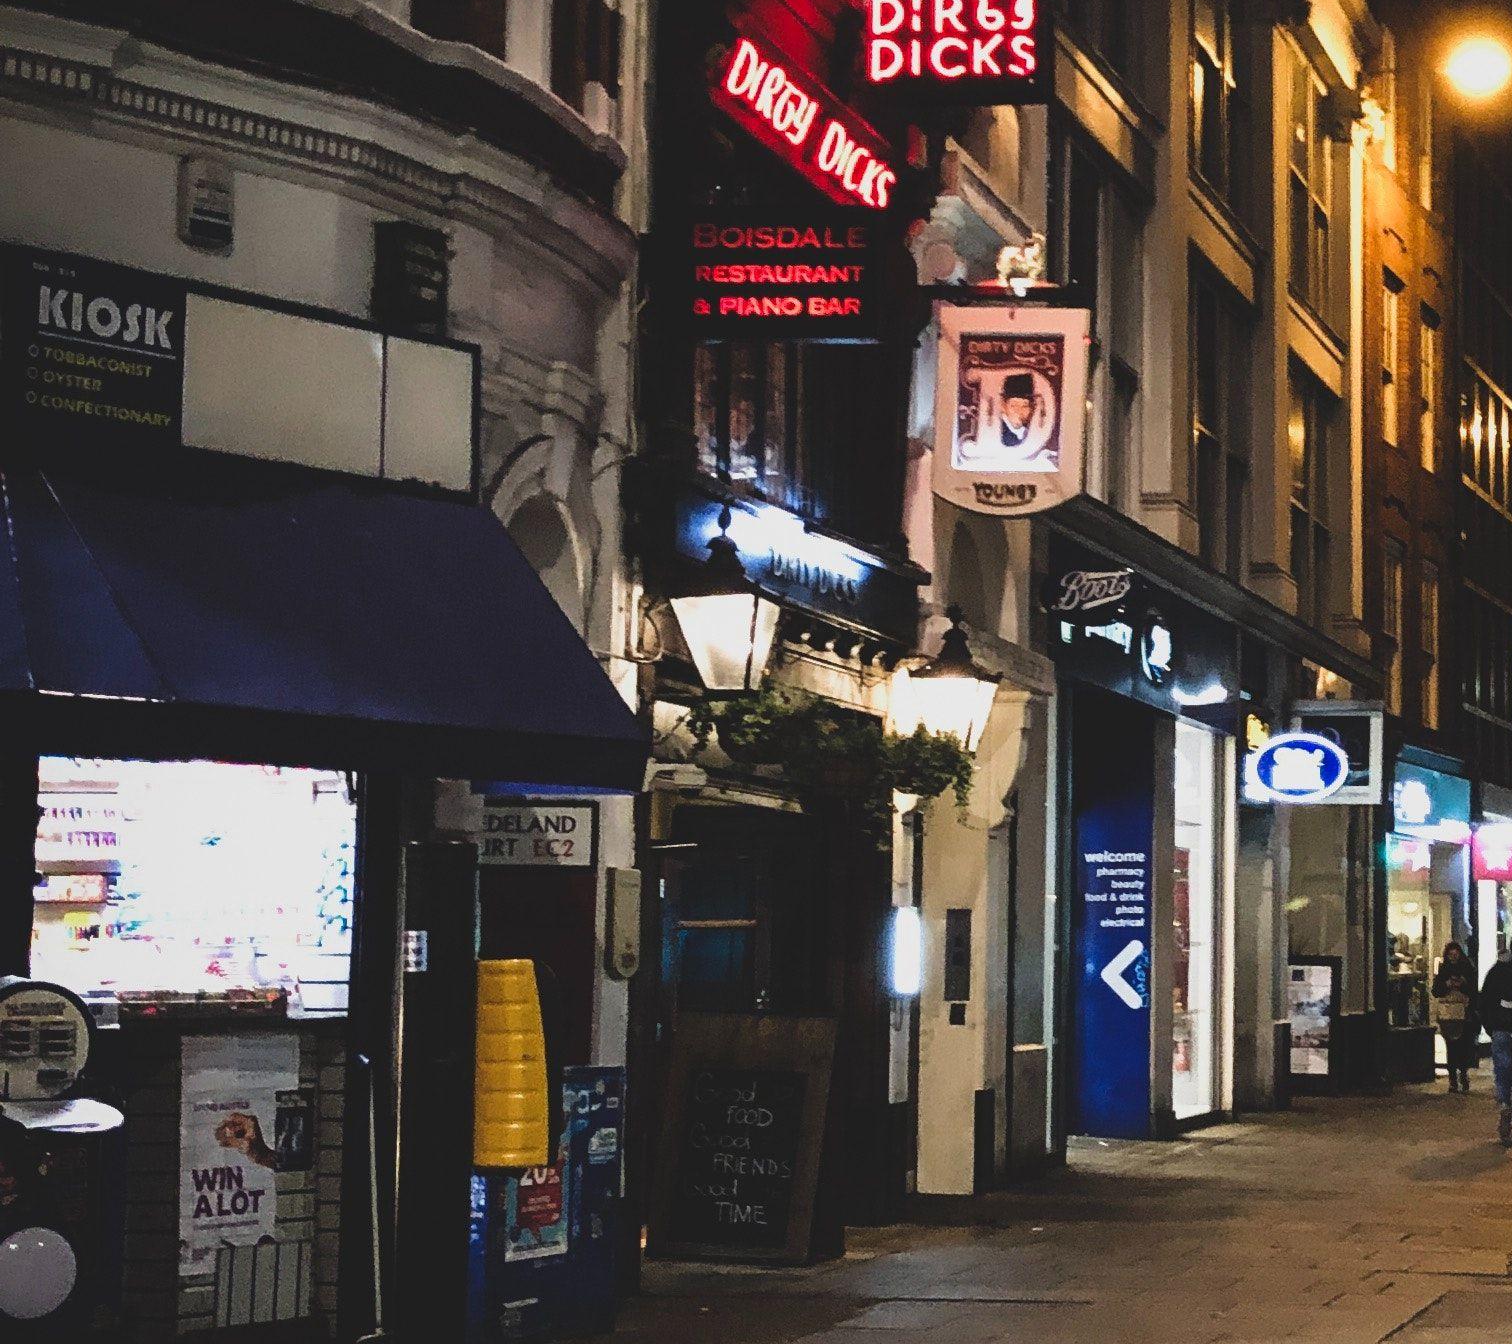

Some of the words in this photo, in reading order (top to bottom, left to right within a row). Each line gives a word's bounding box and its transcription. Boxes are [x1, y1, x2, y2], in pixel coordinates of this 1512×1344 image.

[870, 34, 1036, 81] DICKS
[726, 39, 819, 145] DIRTY
[817, 120, 896, 207] DICKS
[694, 223, 866, 248] BOISDALE
[696, 265, 864, 283] RESTAURANT
[38, 285, 173, 349] KIOSK
[693, 298, 711, 314] &
[719, 297, 803, 316] PIANO
[807, 297, 862, 316] BAR
[43, 370, 102, 391] OYSTER
[1052, 571, 1132, 610] Boots
[533, 839, 575, 857] EC2
[1083, 850, 1146, 863] welcome
[191, 1165, 243, 1192] WIN
